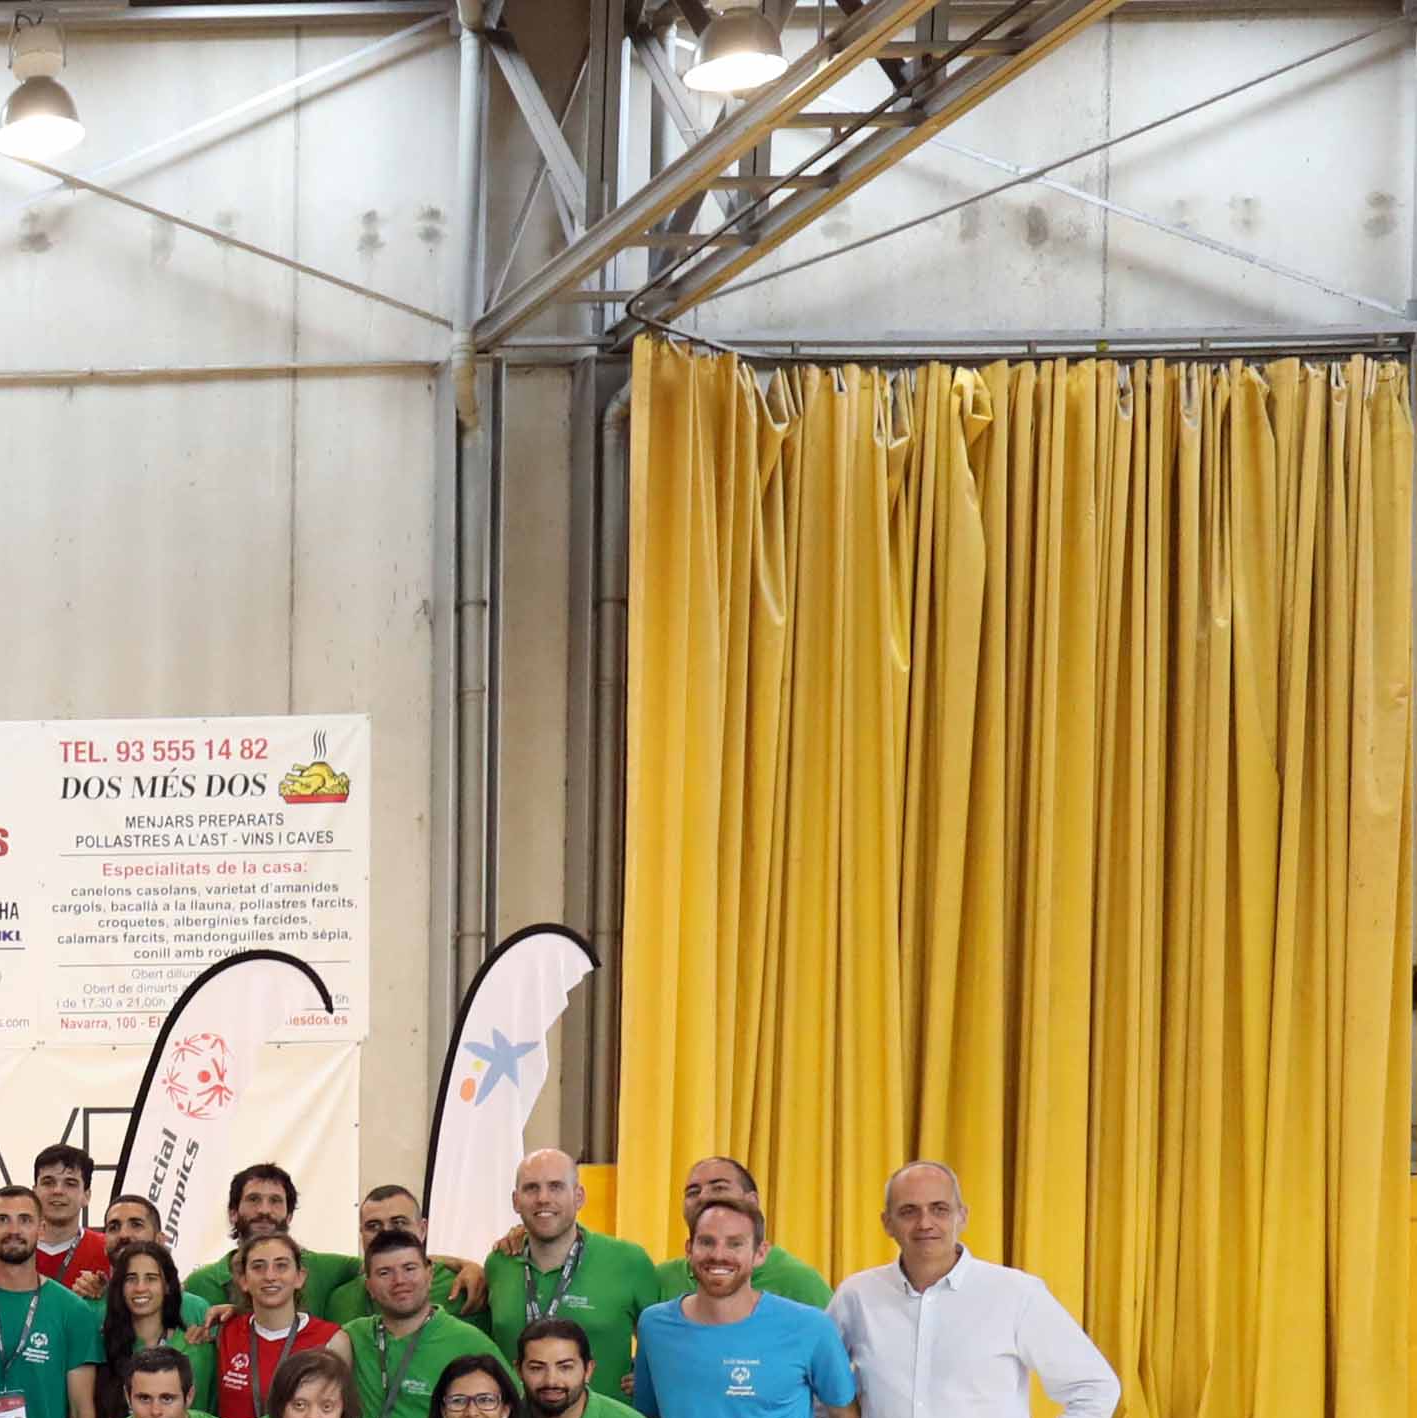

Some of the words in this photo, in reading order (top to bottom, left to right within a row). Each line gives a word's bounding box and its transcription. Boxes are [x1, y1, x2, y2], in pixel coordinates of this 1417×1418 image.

[60, 742, 108, 763] TEL.
[116, 742, 145, 762] 93
[153, 741, 195, 761] 555
[205, 740, 232, 760] 14
[240, 739, 268, 760] 82
[60, 776, 122, 800] DOS
[131, 768, 196, 799] MÉS
[205, 772, 268, 797] DOS
[126, 814, 194, 829] MENJARS
[198, 813, 284, 827] PREPARATS
[76, 833, 172, 848] POLLASTRES
[174, 834, 184, 847] A
[188, 833, 228, 847] L'AST
[242, 831, 274, 845] VINS
[286, 830, 333, 845] CAVES
[102, 862, 210, 879] Especialitats
[218, 862, 236, 874] de
[243, 861, 257, 873] la
[263, 861, 308, 873] casa:
[71, 886, 131, 897] canelons
[137, 885, 201, 898] casolans,
[206, 884, 255, 895] varietat
[261, 882, 339, 893] d'amanides
[52, 902, 106, 915] cargols,
[163, 903, 170, 911] a
[175, 900, 186, 911] la
[190, 899, 234, 912] llauna,
[240, 899, 306, 912] pollastres
[312, 897, 358, 909] farcits,
[98, 917, 169, 930] croquetes,
[253, 914, 311, 926] farcides,
[57, 933, 118, 945] calamars
[123, 932, 169, 944] farcits,
[174, 930, 274, 945] mandonguilles
[279, 930, 308, 941] amb
[134, 948, 170, 959] conill
[175, 948, 204, 959] amb
[131, 969, 163, 979] Obert
[83, 984, 115, 994] Obert
[119, 984, 133, 993] de
[137, 983, 178, 993] dimarts
[60, 1018, 112, 1030] Navarra,
